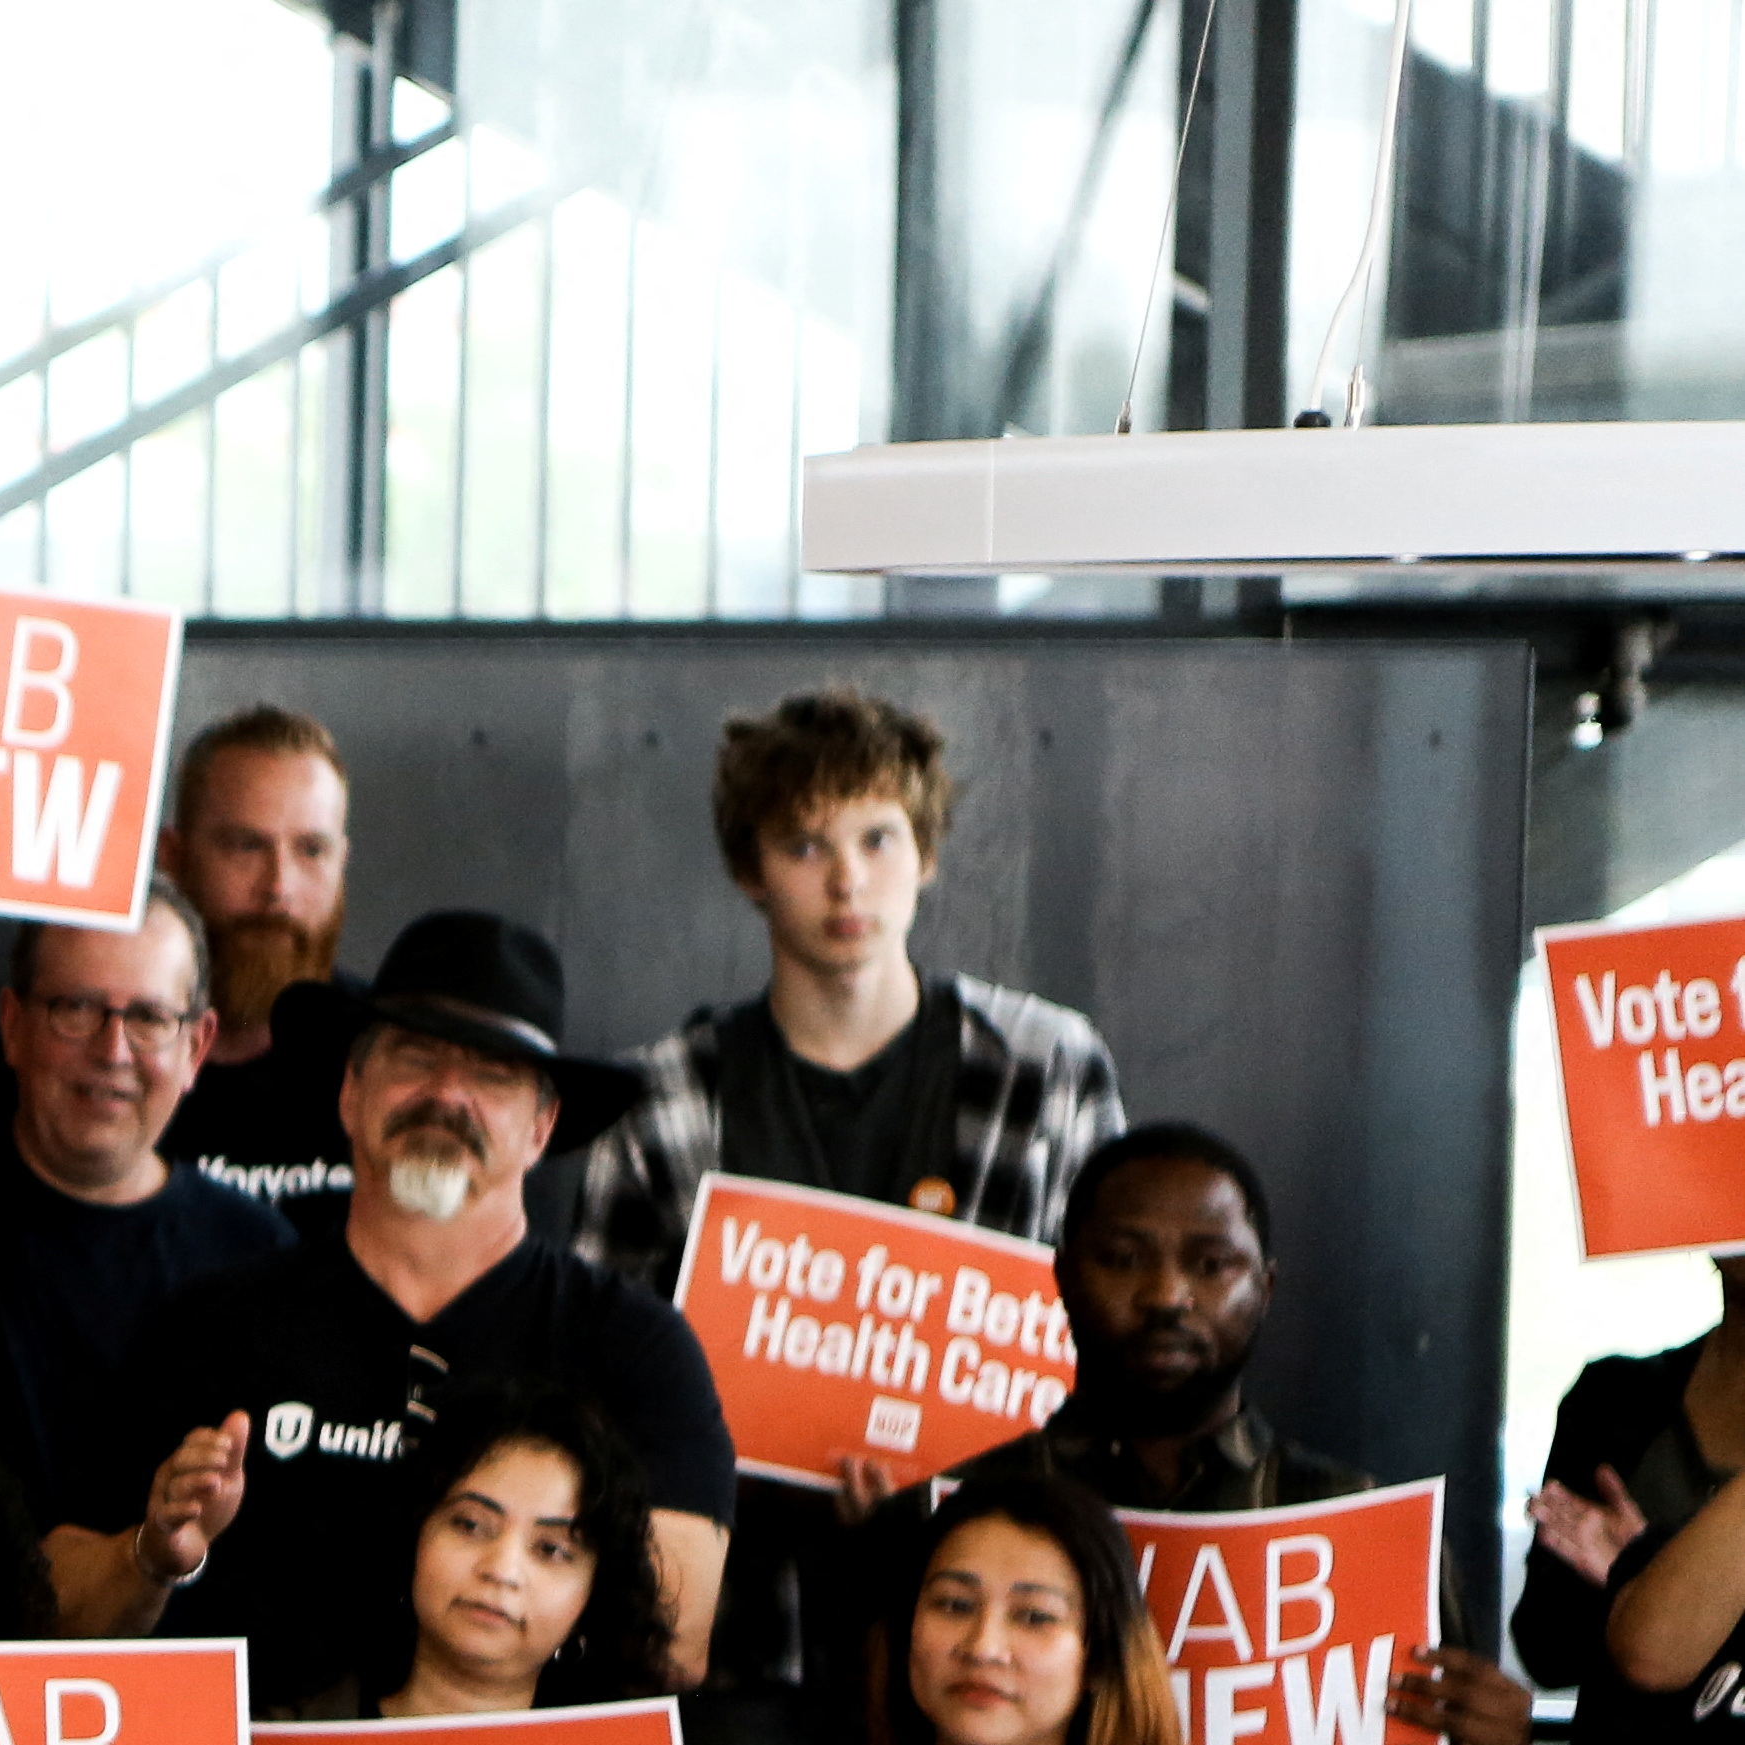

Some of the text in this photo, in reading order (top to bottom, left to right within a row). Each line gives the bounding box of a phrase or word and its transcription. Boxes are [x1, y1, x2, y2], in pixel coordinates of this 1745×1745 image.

[1574, 972, 1721, 1049] Vote
[721, 1218, 1077, 1367] Vote for Bett
[744, 1291, 930, 1393] Health
[319, 1418, 404, 1462] unif
[1137, 1533, 1335, 1663] AB
